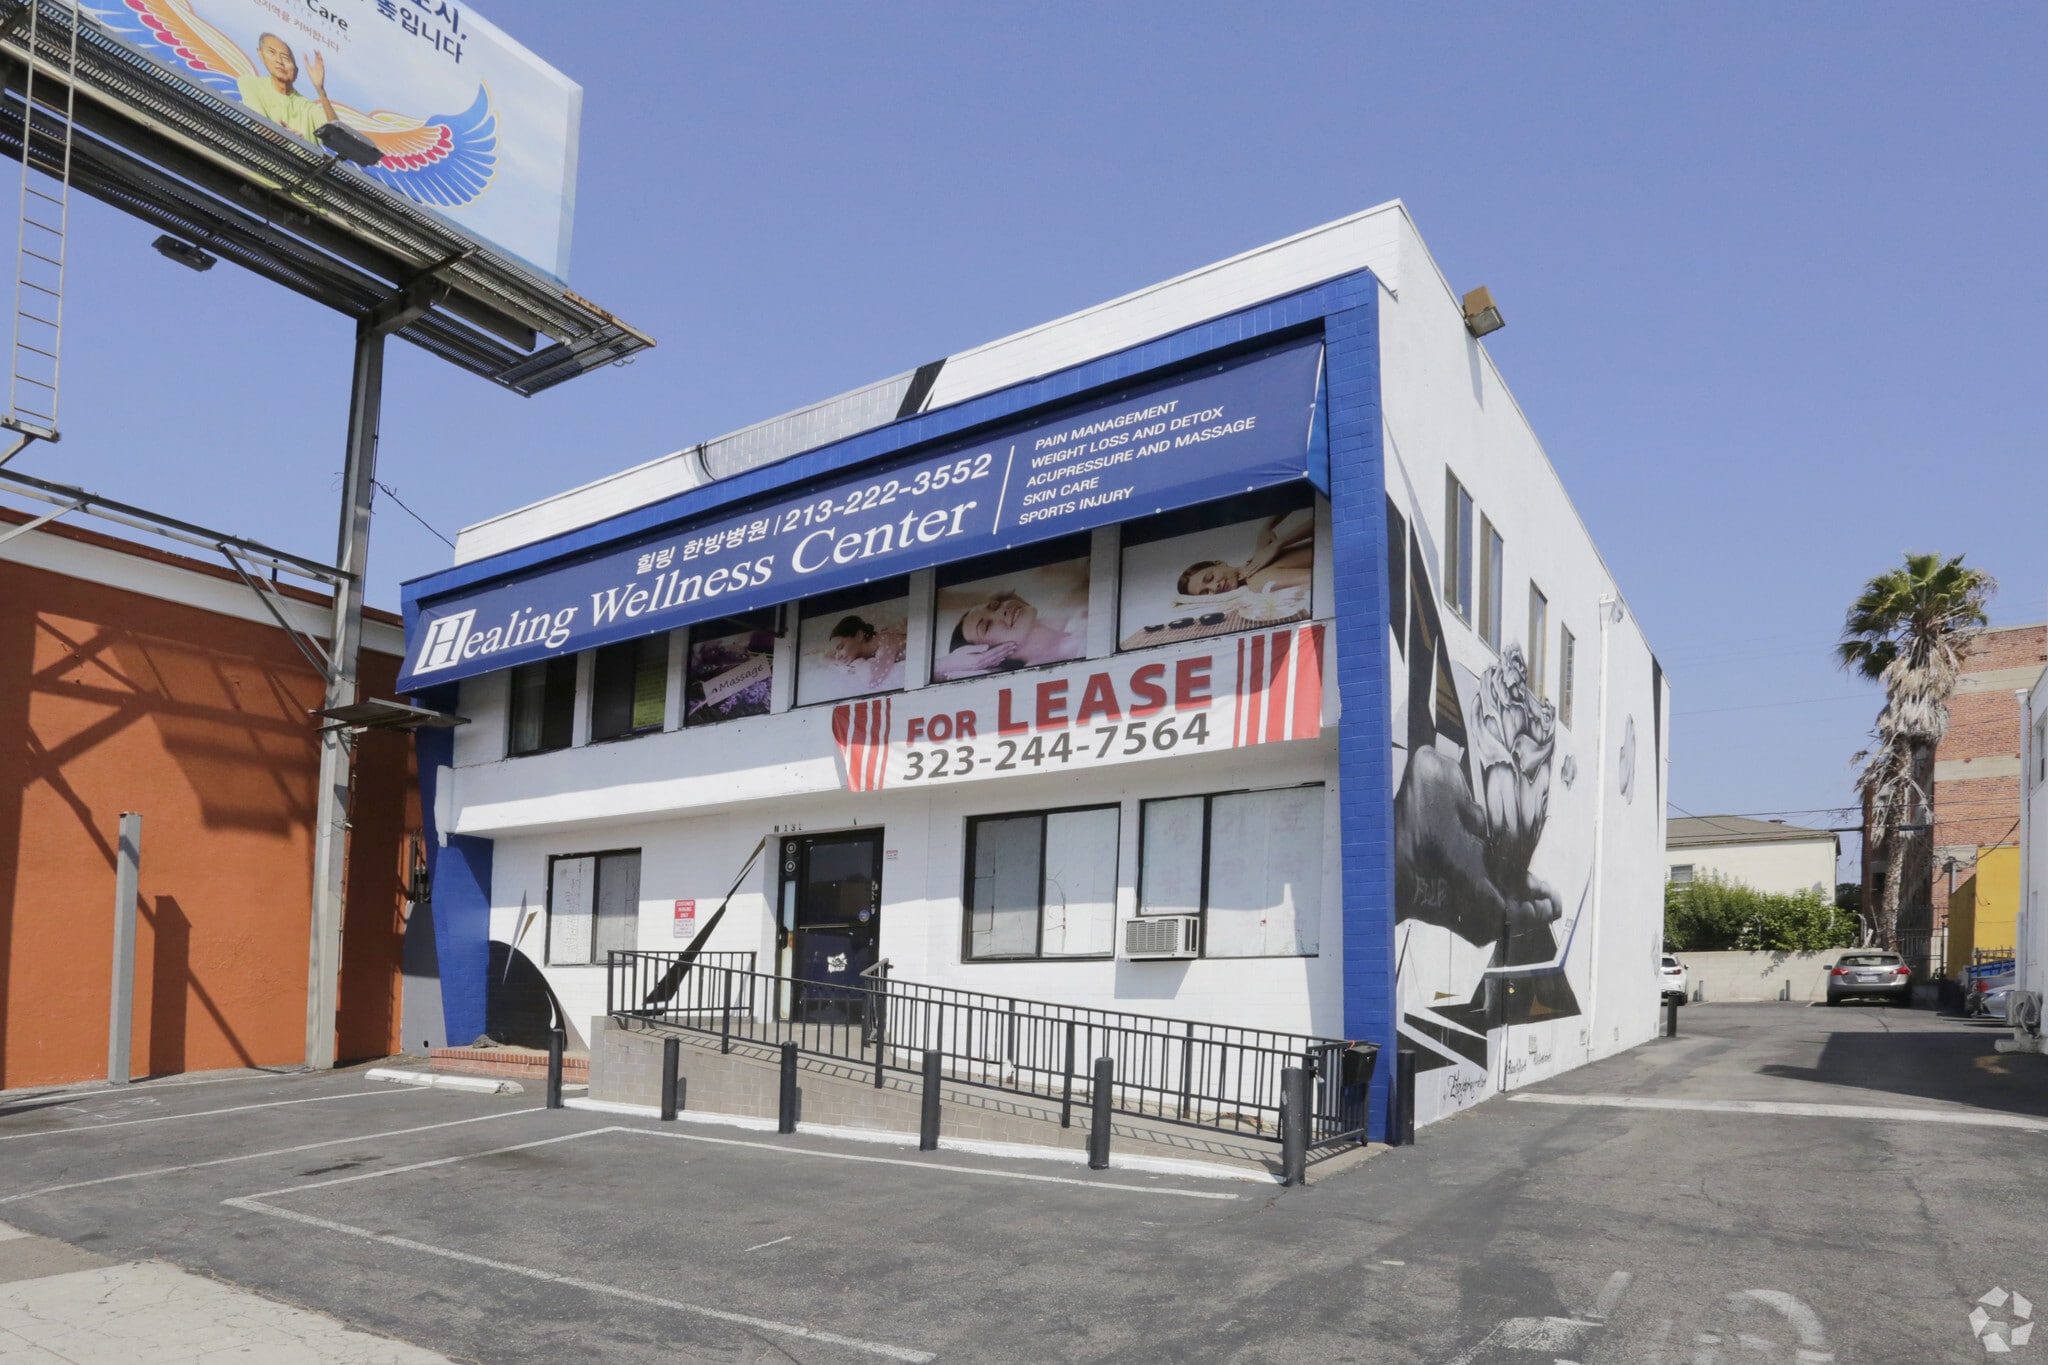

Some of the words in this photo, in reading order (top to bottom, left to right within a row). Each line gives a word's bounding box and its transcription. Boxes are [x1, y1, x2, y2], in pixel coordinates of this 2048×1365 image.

[306, 0, 348, 31] Care
[1026, 449, 1133, 488] ACUPRESSURE
[1135, 440, 1170, 459] AND
[1174, 416, 1257, 448] MASSAGE
[1031, 444, 1087, 469] WEIGHT
[1090, 433, 1130, 453] LOSS
[1132, 422, 1167, 441] AND
[1170, 406, 1225, 431] DETOX
[1035, 432, 1068, 451] PAIN
[1070, 400, 1179, 441] MANAGEMENT
[636, 546, 676, 575] 힐링
[682, 518, 770, 560] 한방병원
[782, 453, 992, 533] 213-222-3552
[1019, 502, 1076, 526] SPORTS
[1079, 486, 1135, 510] INJURY
[1022, 487, 1057, 507] SKIN
[1060, 477, 1100, 497] CARE
[412, 607, 579, 675] Healing
[591, 554, 775, 627] Wellness
[791, 500, 977, 574] Center
[718, 664, 764, 692] Massage
[905, 709, 977, 746] FOR
[997, 655, 1214, 738] LEASE
[903, 712, 1211, 782] 323-244-7564
